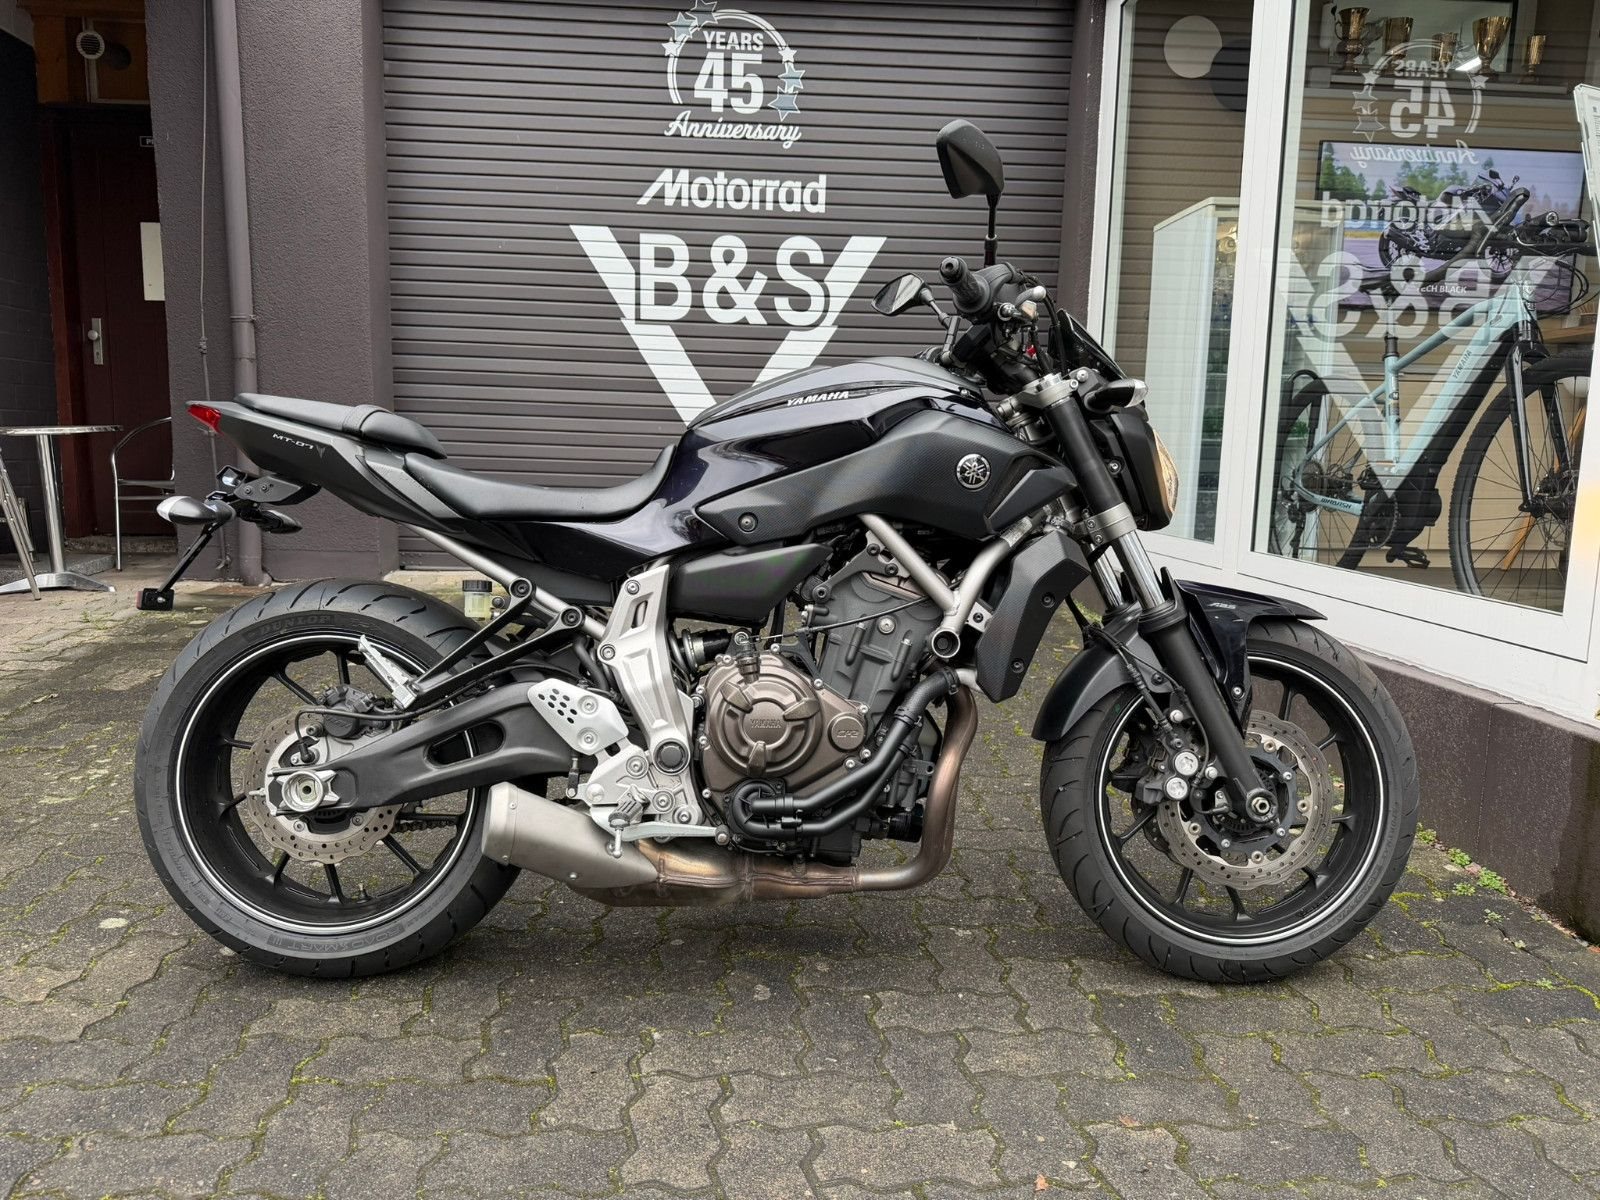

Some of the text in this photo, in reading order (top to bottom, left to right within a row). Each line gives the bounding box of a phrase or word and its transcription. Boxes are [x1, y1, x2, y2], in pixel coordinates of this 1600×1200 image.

[702, 30, 764, 51] YEARS
[693, 52, 764, 115] 45
[664, 110, 802, 149] Anniversary
[636, 168, 827, 213] Motorrad
[639, 233, 826, 326] B&S
[1439, 285, 1468, 294] BLACK
[787, 391, 849, 406] YAMAHA
[272, 433, 314, 450] MT-07
